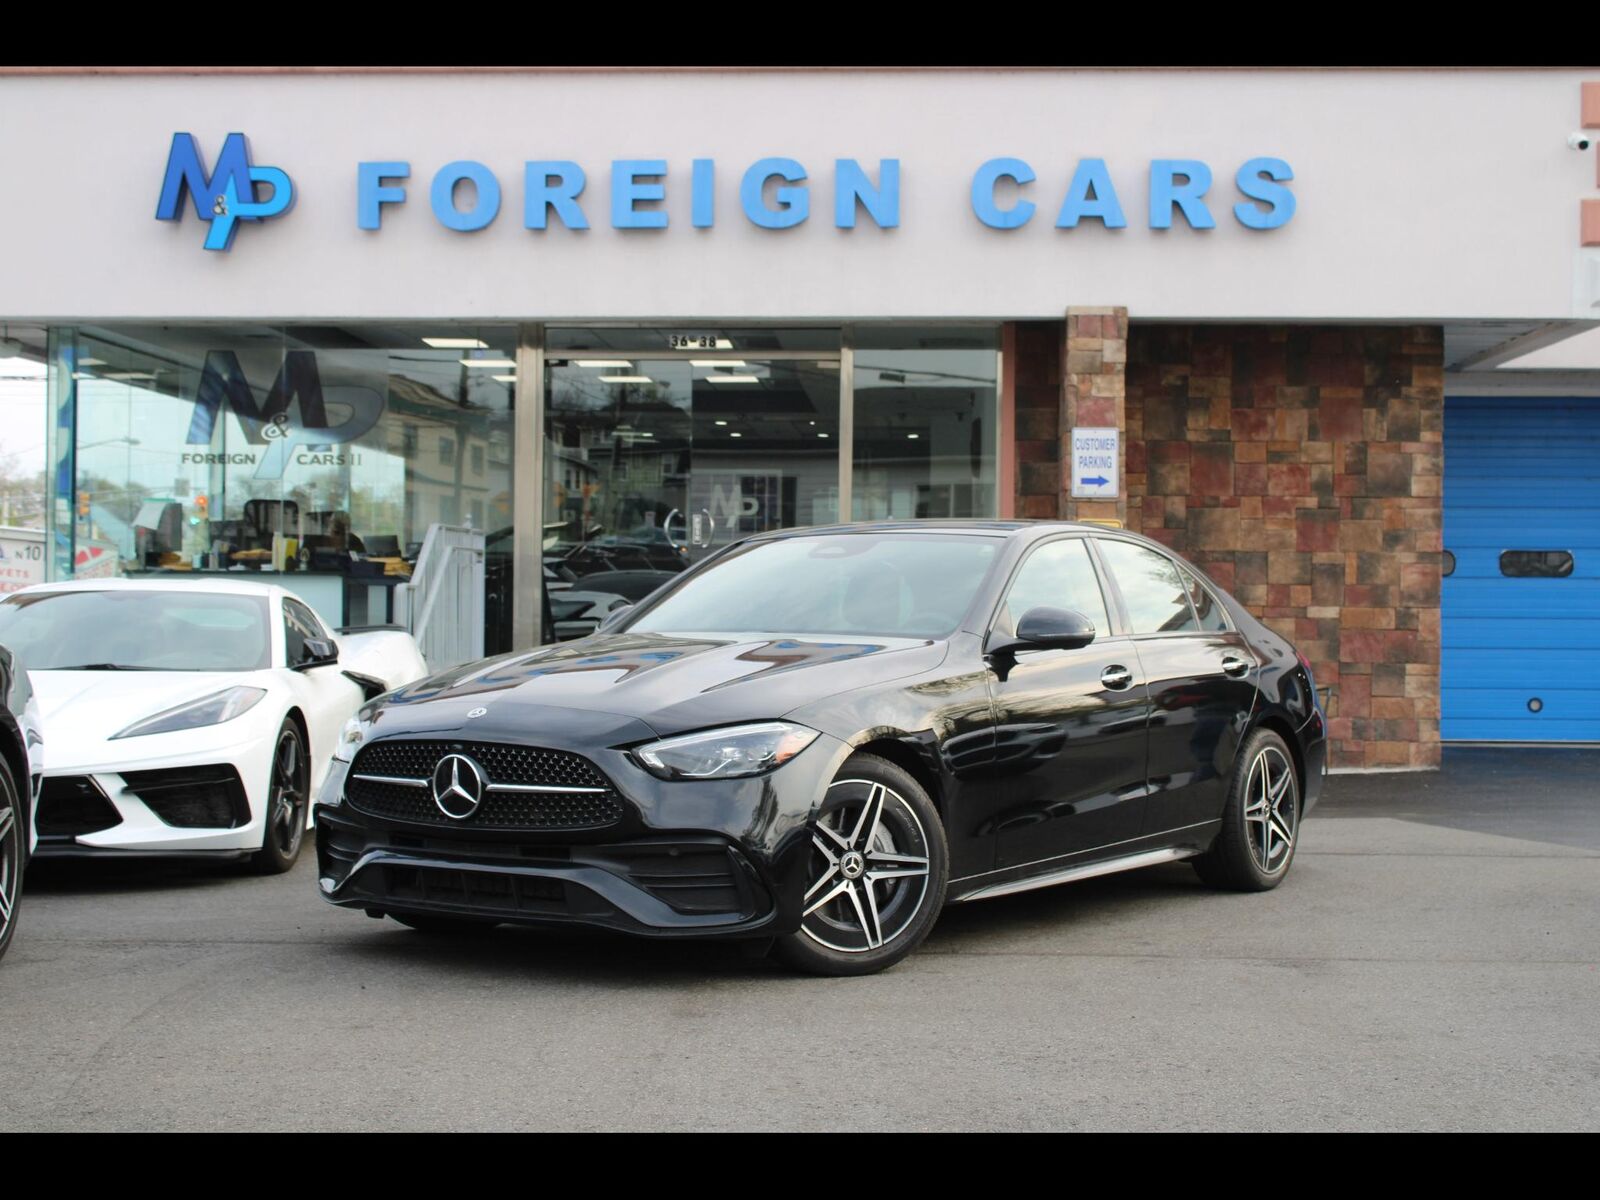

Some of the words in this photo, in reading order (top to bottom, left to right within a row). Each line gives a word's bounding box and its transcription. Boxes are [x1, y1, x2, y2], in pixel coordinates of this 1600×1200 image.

[357, 158, 901, 231] FOREIGN
[970, 156, 1297, 230] CARS
[671, 335, 716, 348] 36-38
[1075, 438, 1116, 451] CUSTOMER
[181, 453, 256, 465] FOREIGN
[296, 453, 345, 466] CARS
[1079, 455, 1112, 469] PARKING
